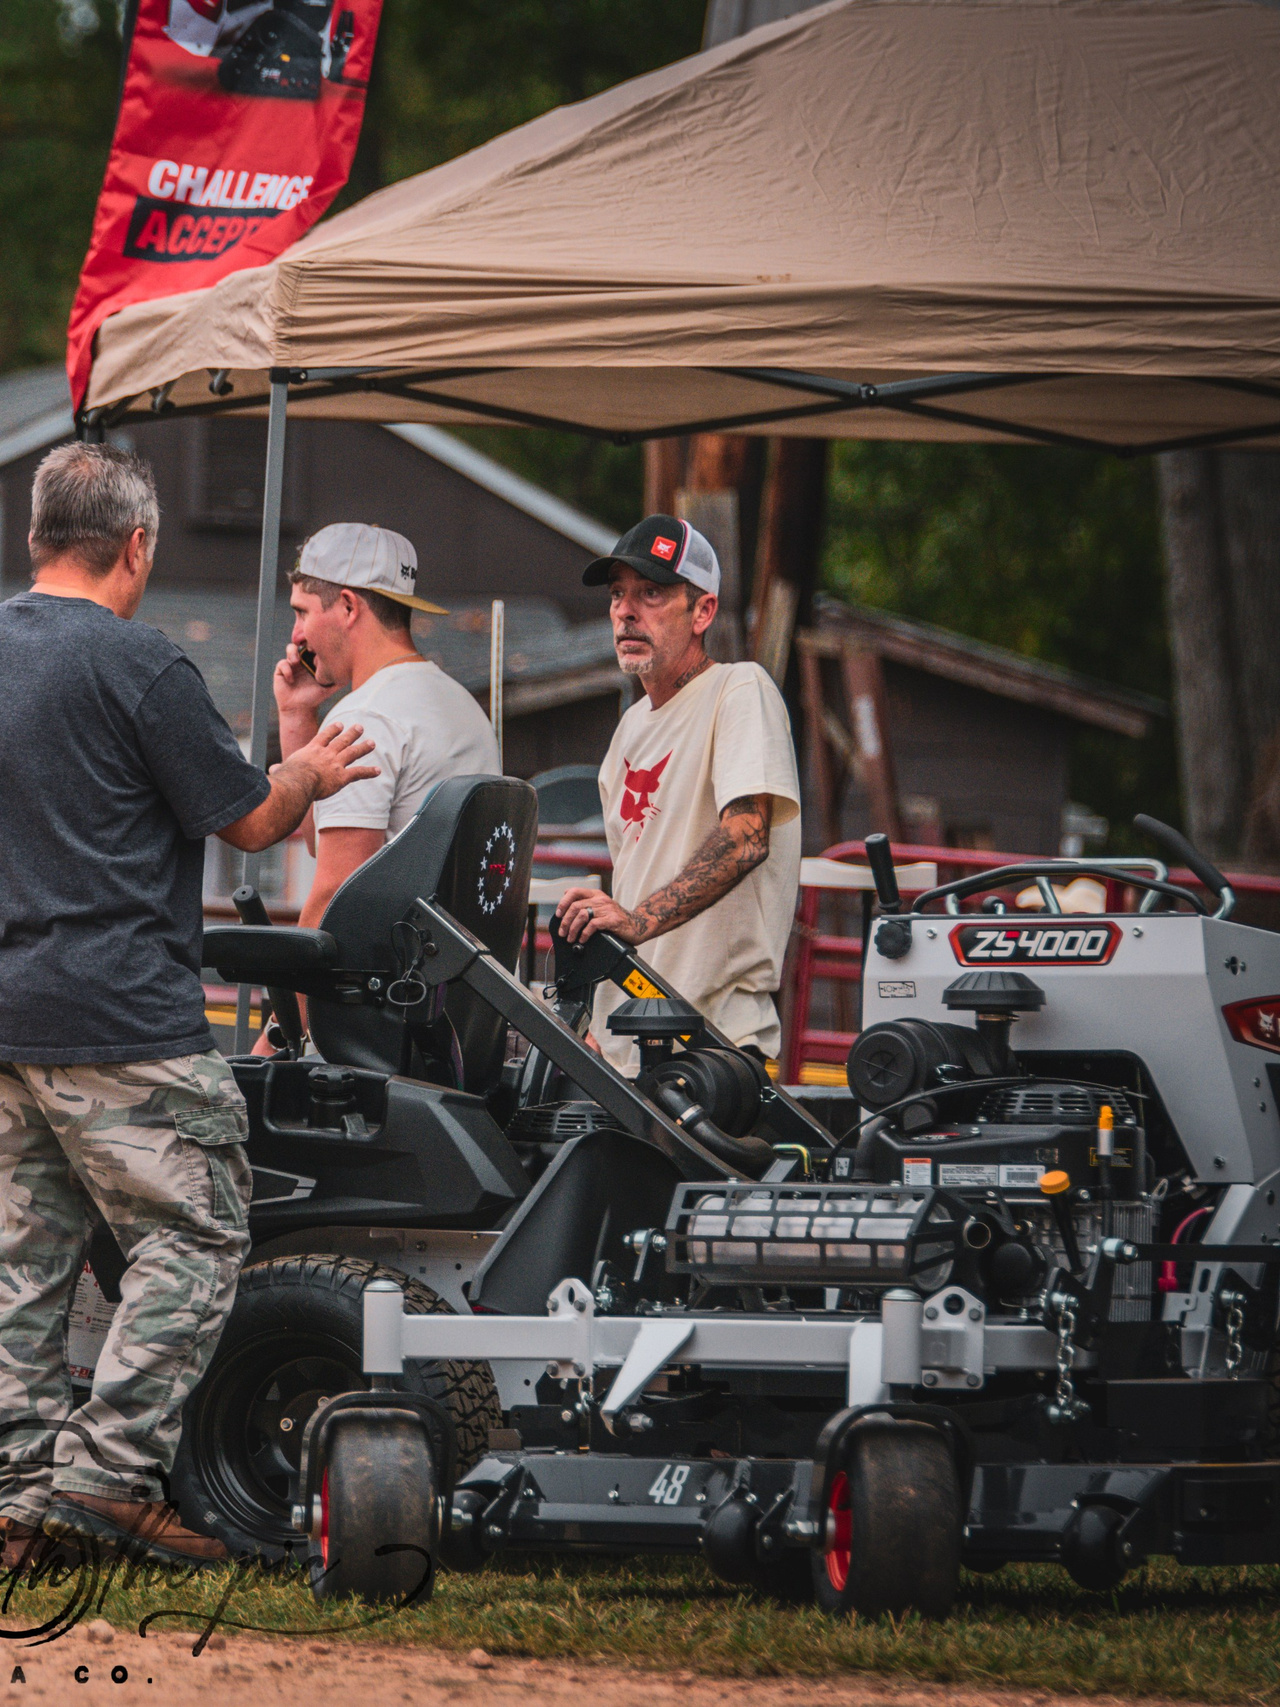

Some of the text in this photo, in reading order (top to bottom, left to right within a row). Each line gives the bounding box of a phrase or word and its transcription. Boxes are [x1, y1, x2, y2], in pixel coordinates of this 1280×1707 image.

[147, 159, 314, 211] CHALLENGE
[134, 209, 276, 255] ACCEPT
[968, 930, 1109, 957] ZS4000
[648, 1464, 691, 1505] 48
